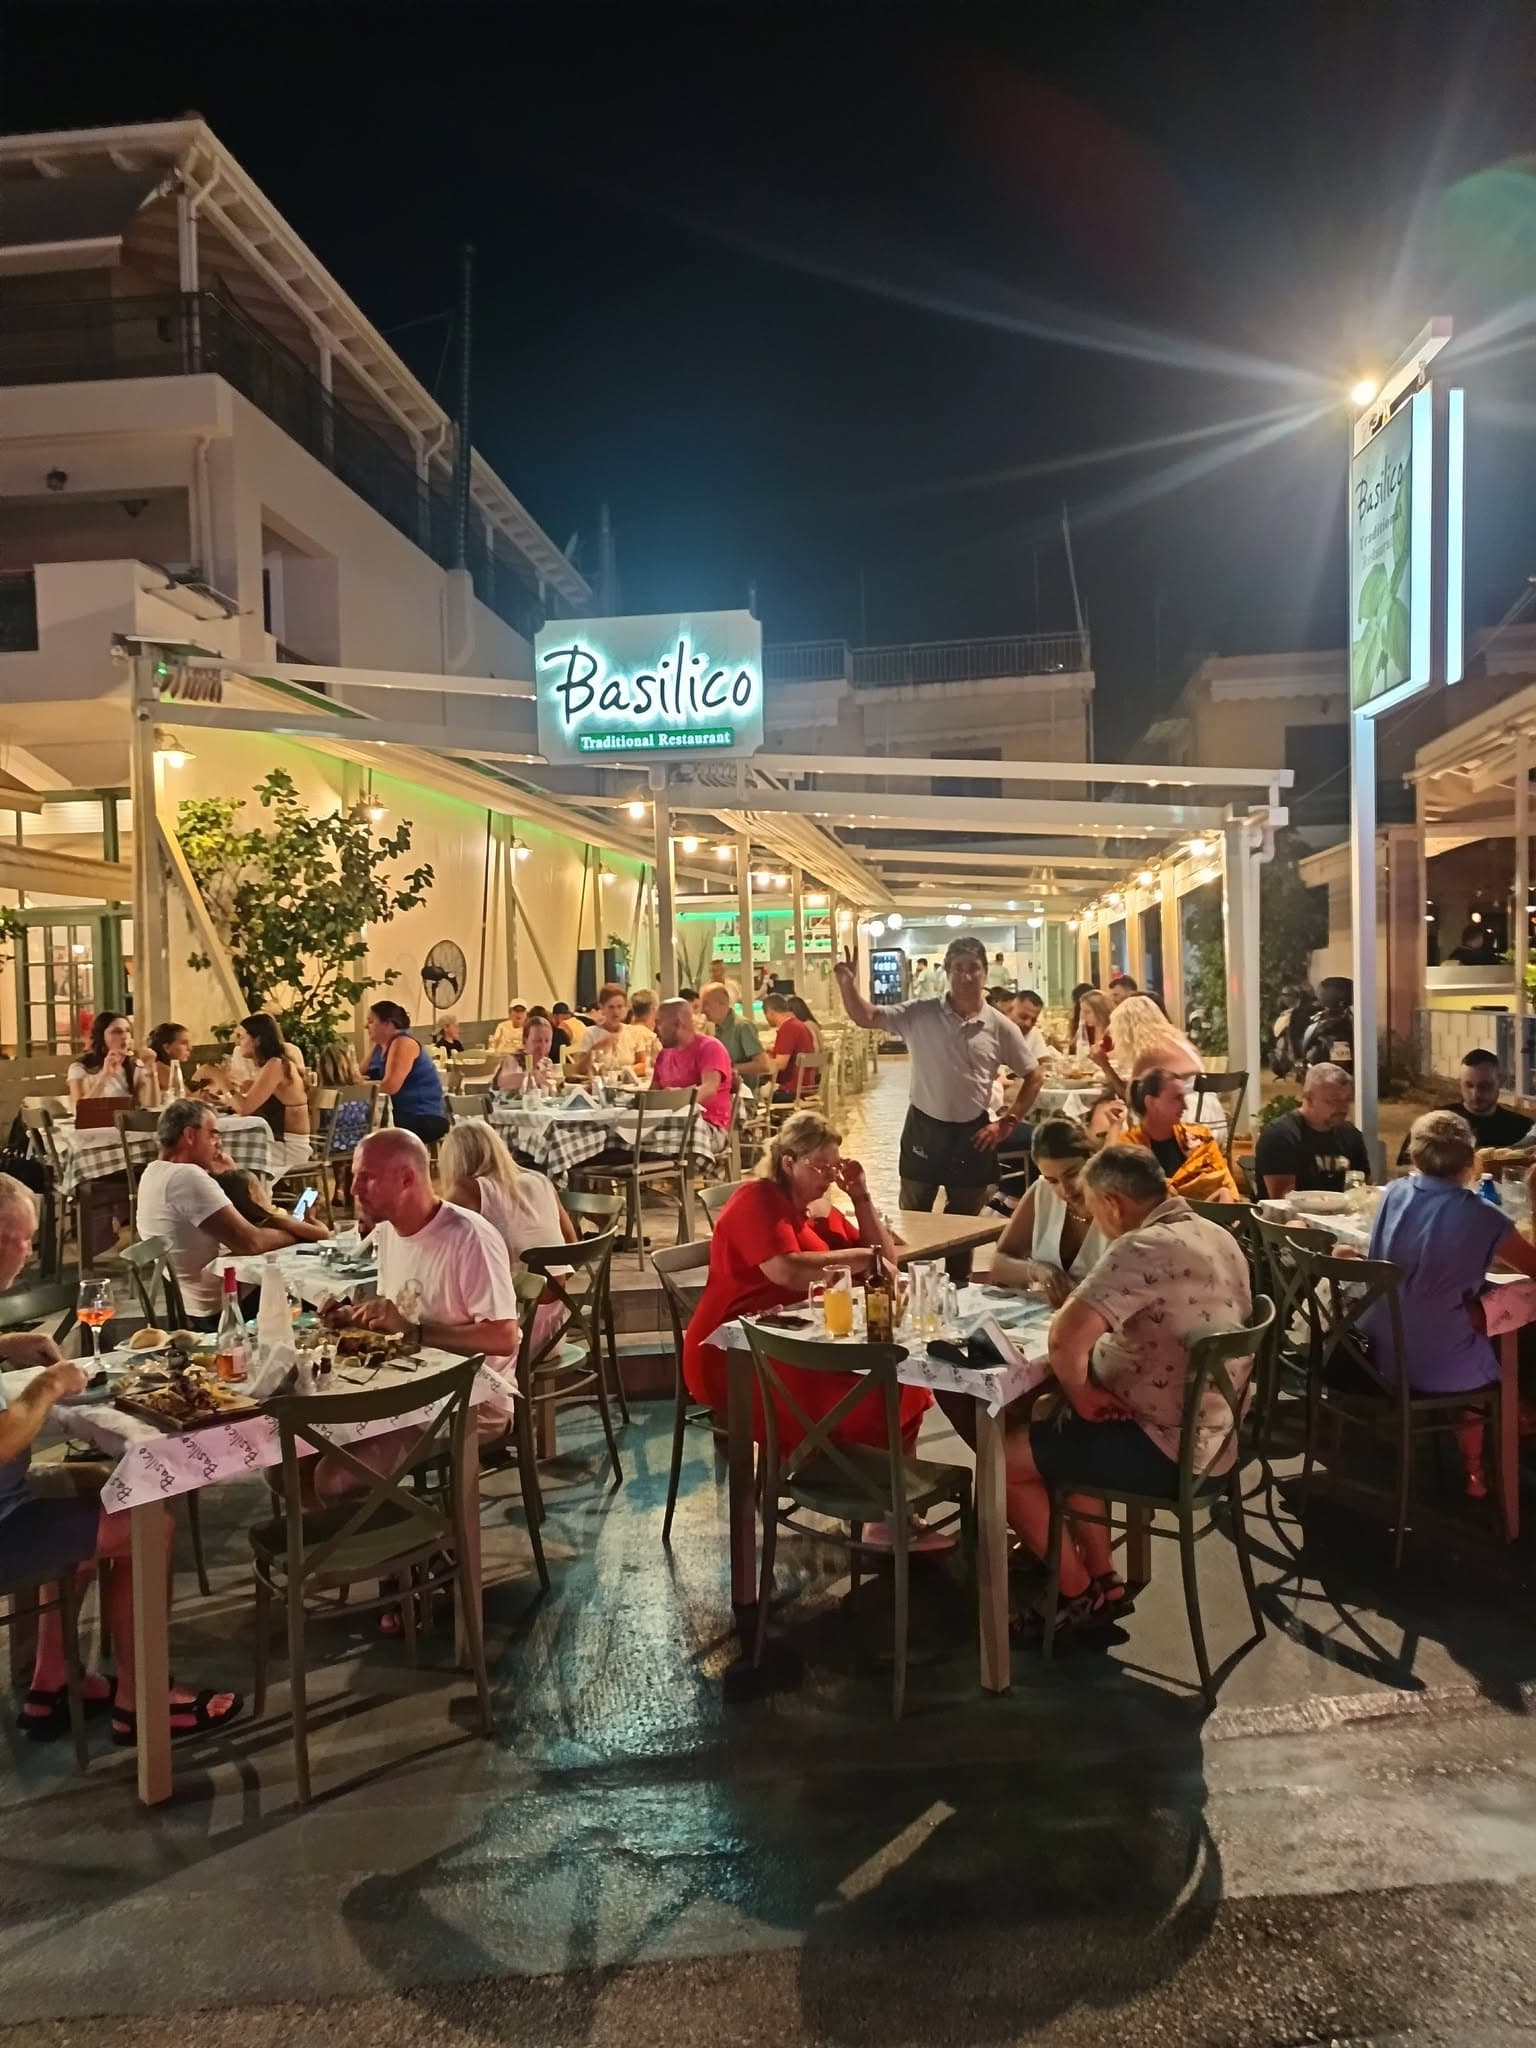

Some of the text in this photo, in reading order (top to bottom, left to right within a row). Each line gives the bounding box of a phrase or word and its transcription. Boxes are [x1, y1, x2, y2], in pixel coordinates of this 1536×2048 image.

[1355, 455, 1403, 528] Basilico
[544, 641, 752, 724] Basilico
[580, 731, 730, 749] Traditional Restaurant
[182, 1437, 218, 1480] Basilico
[224, 1425, 258, 1468] Basilico
[139, 1447, 176, 1493] Basilico
